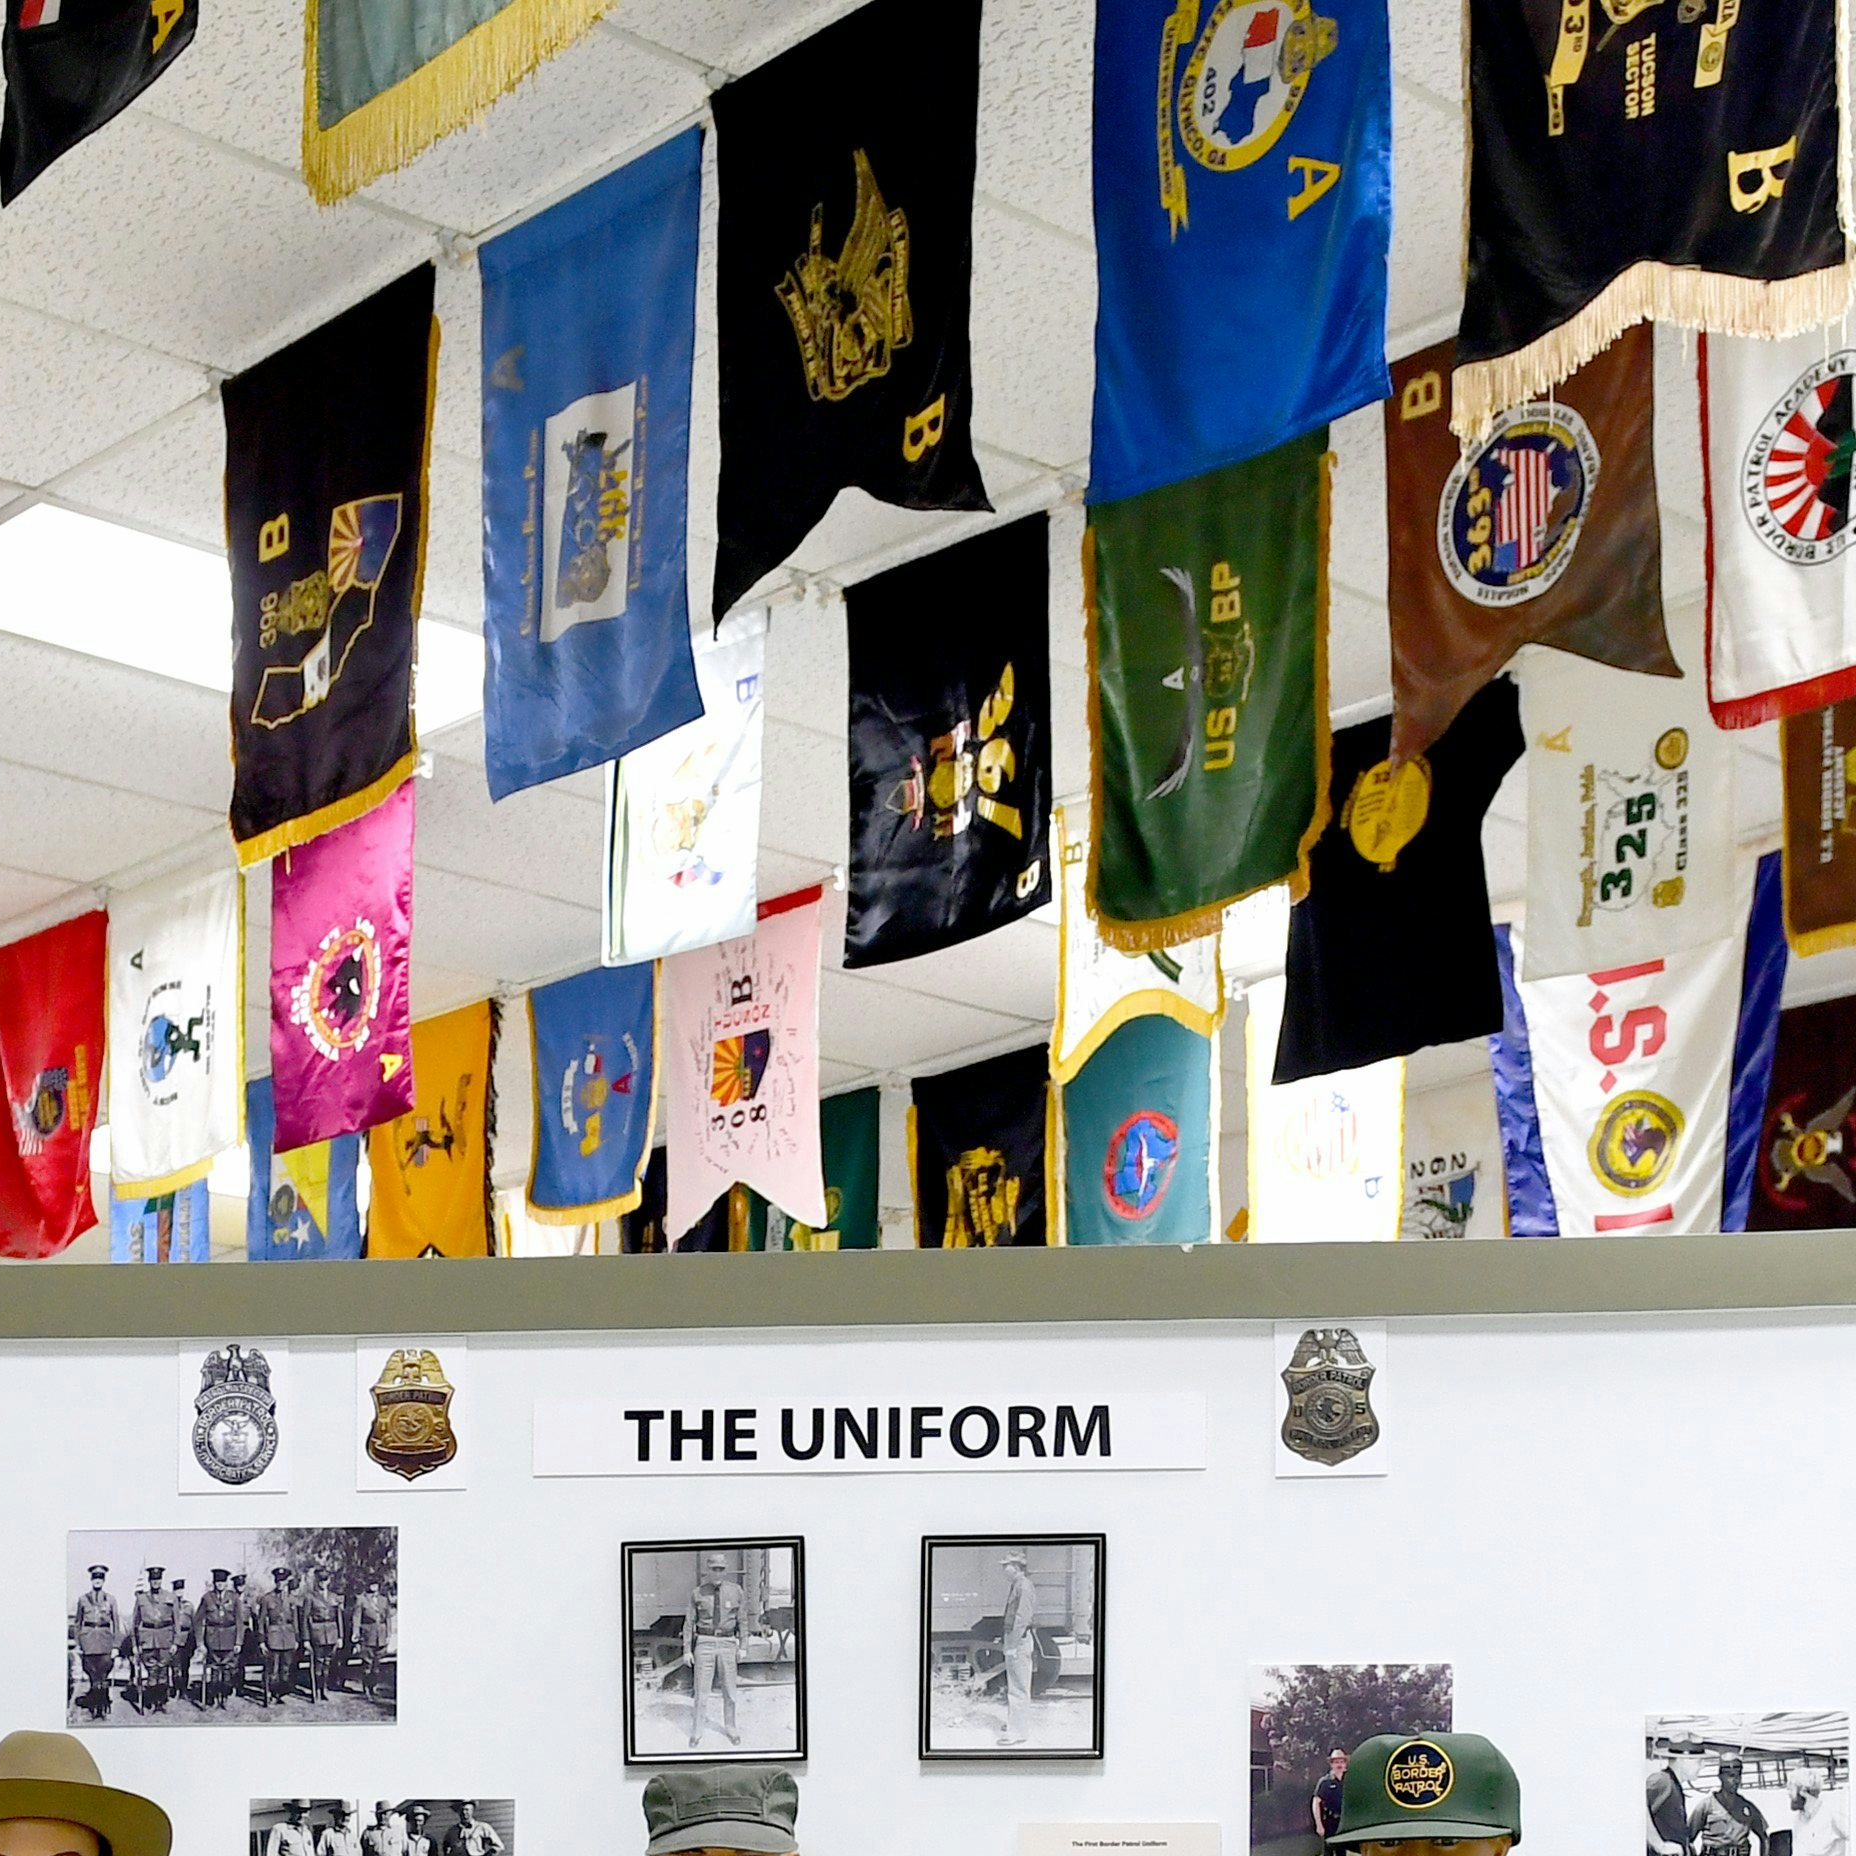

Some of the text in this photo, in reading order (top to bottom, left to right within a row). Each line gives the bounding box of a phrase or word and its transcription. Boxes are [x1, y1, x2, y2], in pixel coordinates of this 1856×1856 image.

[1201, 67, 1218, 117] 402
[1624, 40, 1640, 120] SECTOR
[1639, 32, 1657, 117] TUCSON
[1287, 155, 1342, 221] A
[1728, 135, 1798, 214] B
[789, 292, 813, 336] PROUD
[1400, 370, 1442, 421] B
[1774, 356, 1848, 426] ACADEMY
[903, 393, 945, 463] B
[1746, 431, 1775, 511] PATROL
[259, 512, 290, 563] B
[1755, 514, 1817, 561] BORDER
[1210, 560, 1242, 622] BP
[258, 592, 280, 649] 396
[1162, 666, 1185, 691] A
[1202, 706, 1237, 773] US
[1537, 723, 1572, 753] A
[1064, 840, 1082, 864] B
[1600, 791, 1657, 903] 325
[1675, 814, 1688, 871] Class
[1016, 860, 1042, 899] B
[130, 948, 144, 971] A
[731, 973, 753, 1006] B
[714, 1004, 771, 1029] TUCSON
[380, 1053, 404, 1082] A
[610, 1072, 633, 1095] A
[710, 1102, 767, 1132] 308
[1330, 1370, 1366, 1391] PATROL
[199, 1399, 273, 1430] BORDER PATROL
[1355, 1402, 1366, 1415] S
[624, 1405, 1112, 1462] THE UNIFORM
[1393, 1767, 1444, 1780] BORDER
[1408, 1754, 1430, 1765] U.S.
[1395, 1781, 1443, 1793] PATROL
